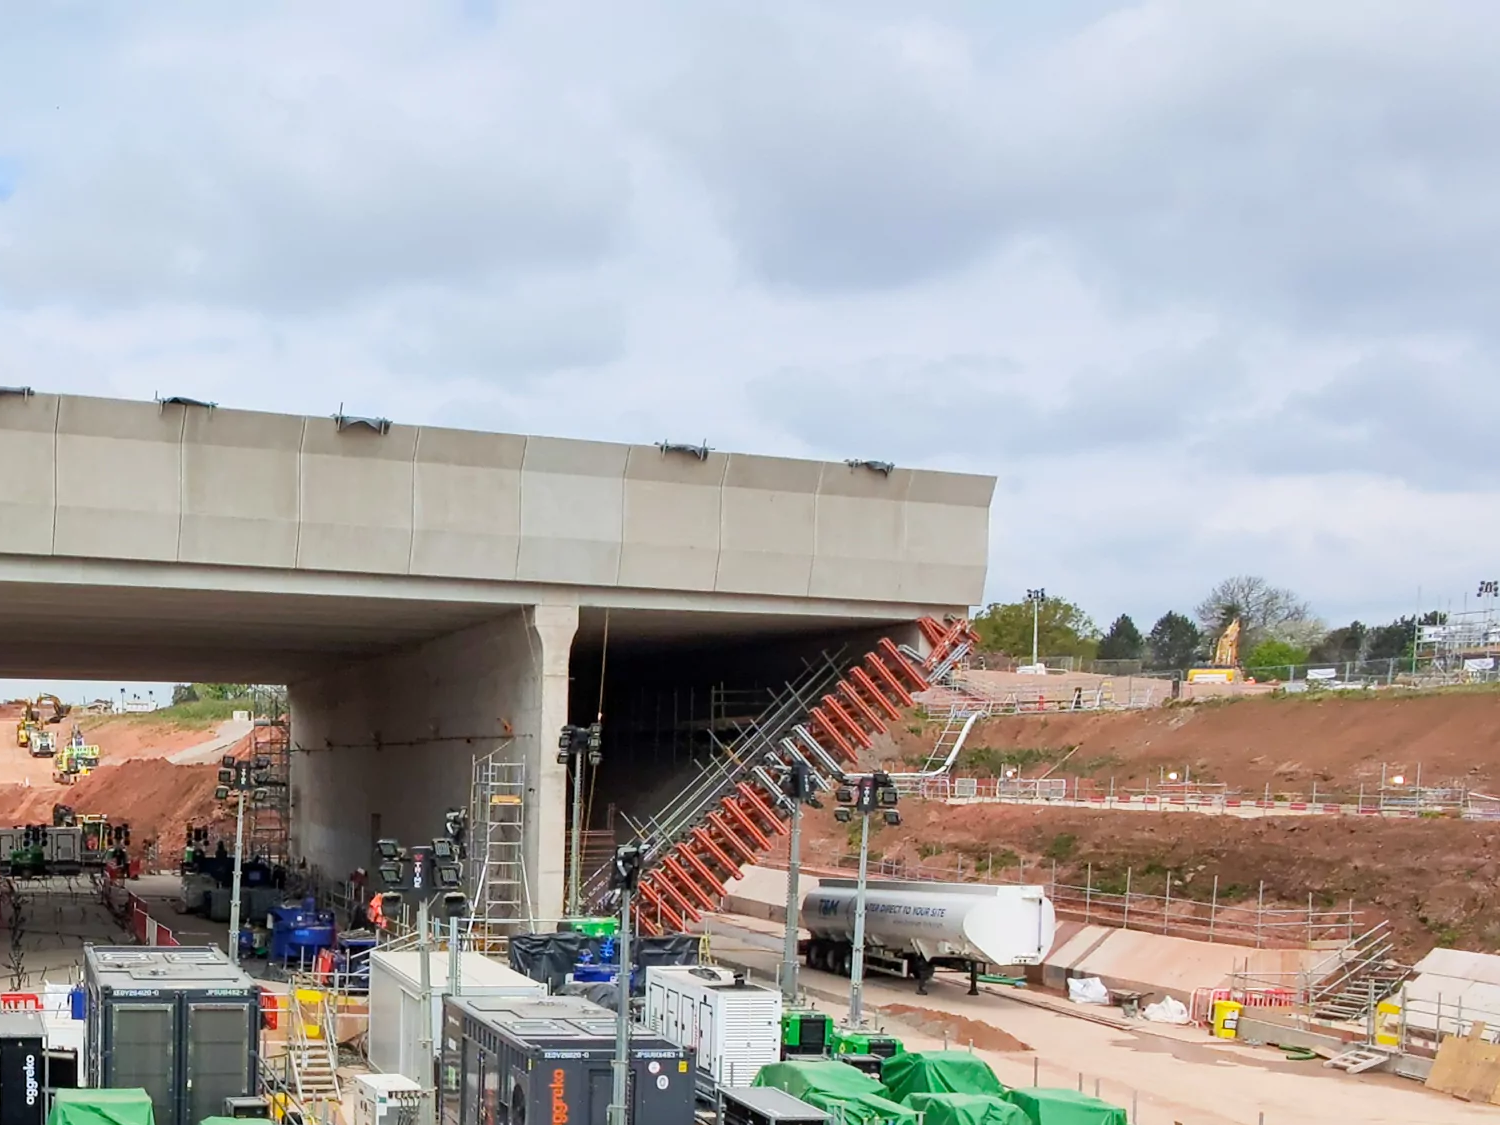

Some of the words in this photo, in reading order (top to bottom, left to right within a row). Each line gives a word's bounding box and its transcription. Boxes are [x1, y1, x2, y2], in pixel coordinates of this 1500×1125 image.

[903, 905, 911, 915] TO
[913, 906, 930, 916] YOUR
[930, 908, 946, 918] SITE
[23, 1054, 39, 1105] aggreko
